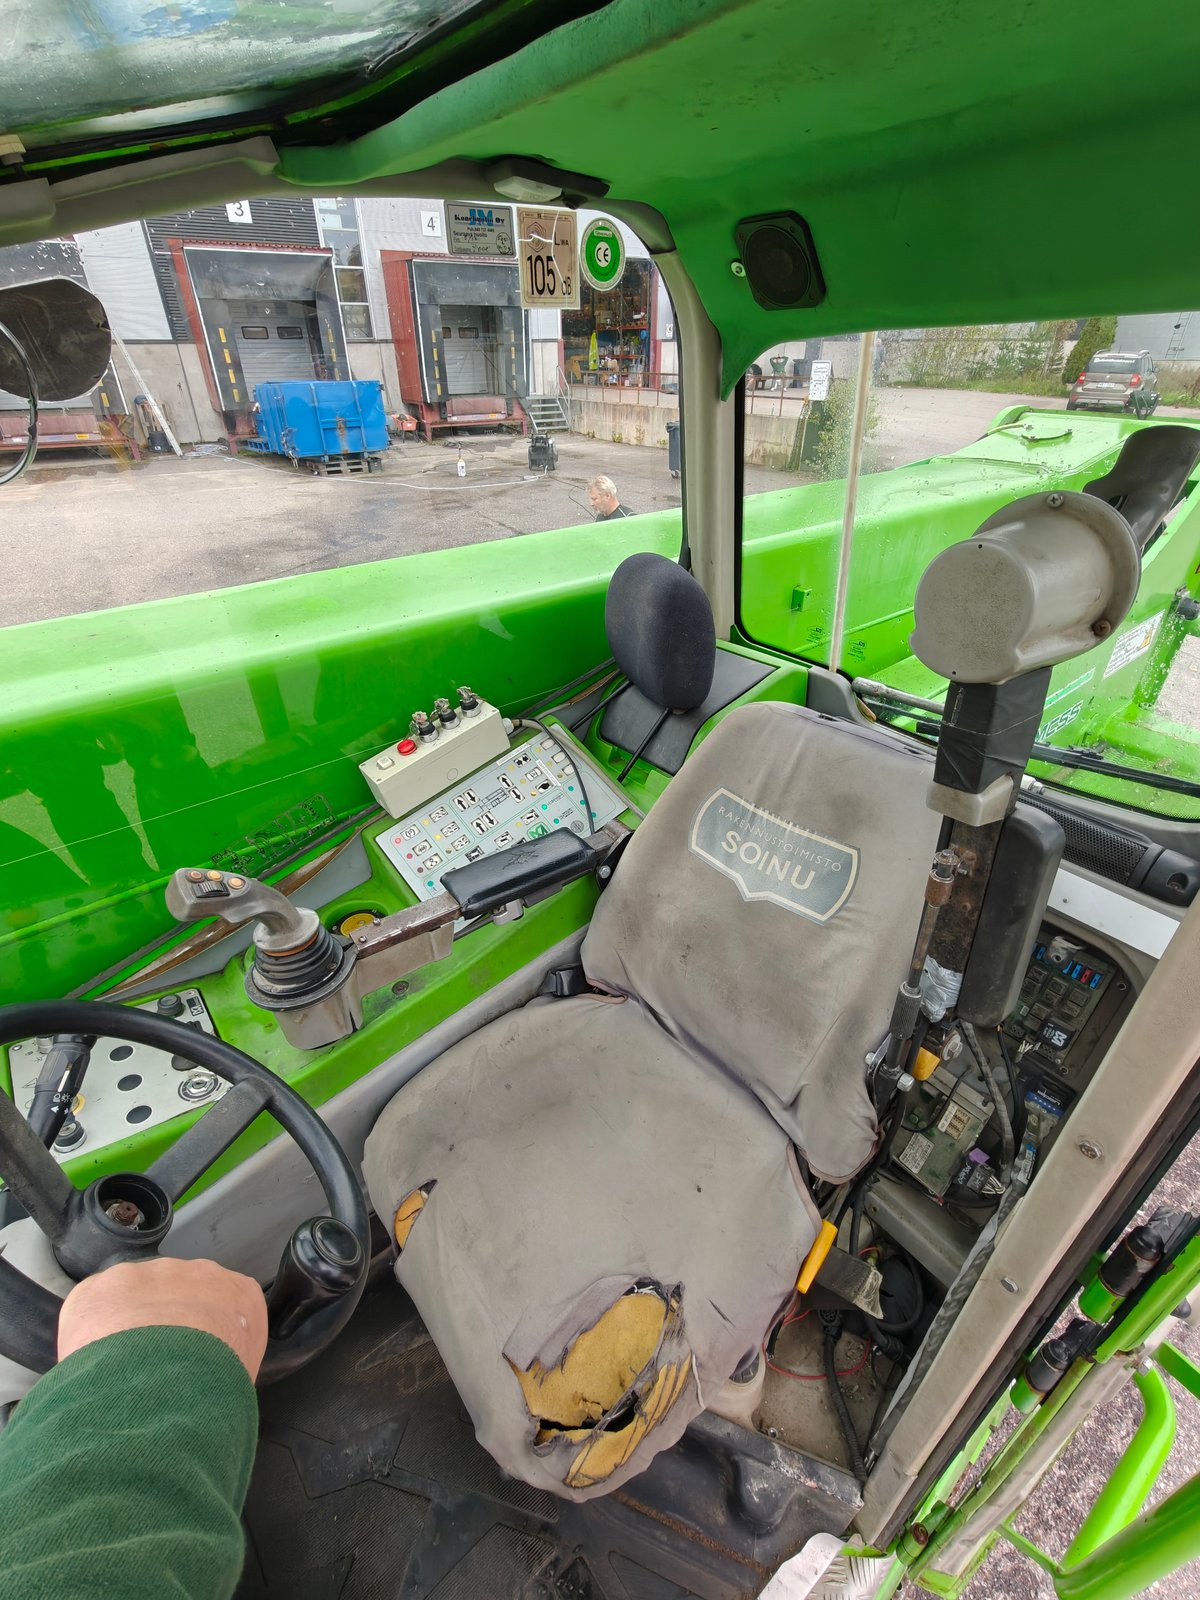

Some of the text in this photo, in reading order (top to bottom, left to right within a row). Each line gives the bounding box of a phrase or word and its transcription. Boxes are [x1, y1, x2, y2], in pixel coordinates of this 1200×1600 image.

[233, 201, 244, 217] 3
[495, 217, 505, 225] Oy
[427, 216, 436, 231] 4
[527, 255, 556, 296] 105
[718, 807, 841, 872] RAKENNUSTOIMISTO
[721, 830, 816, 890] SOINU
